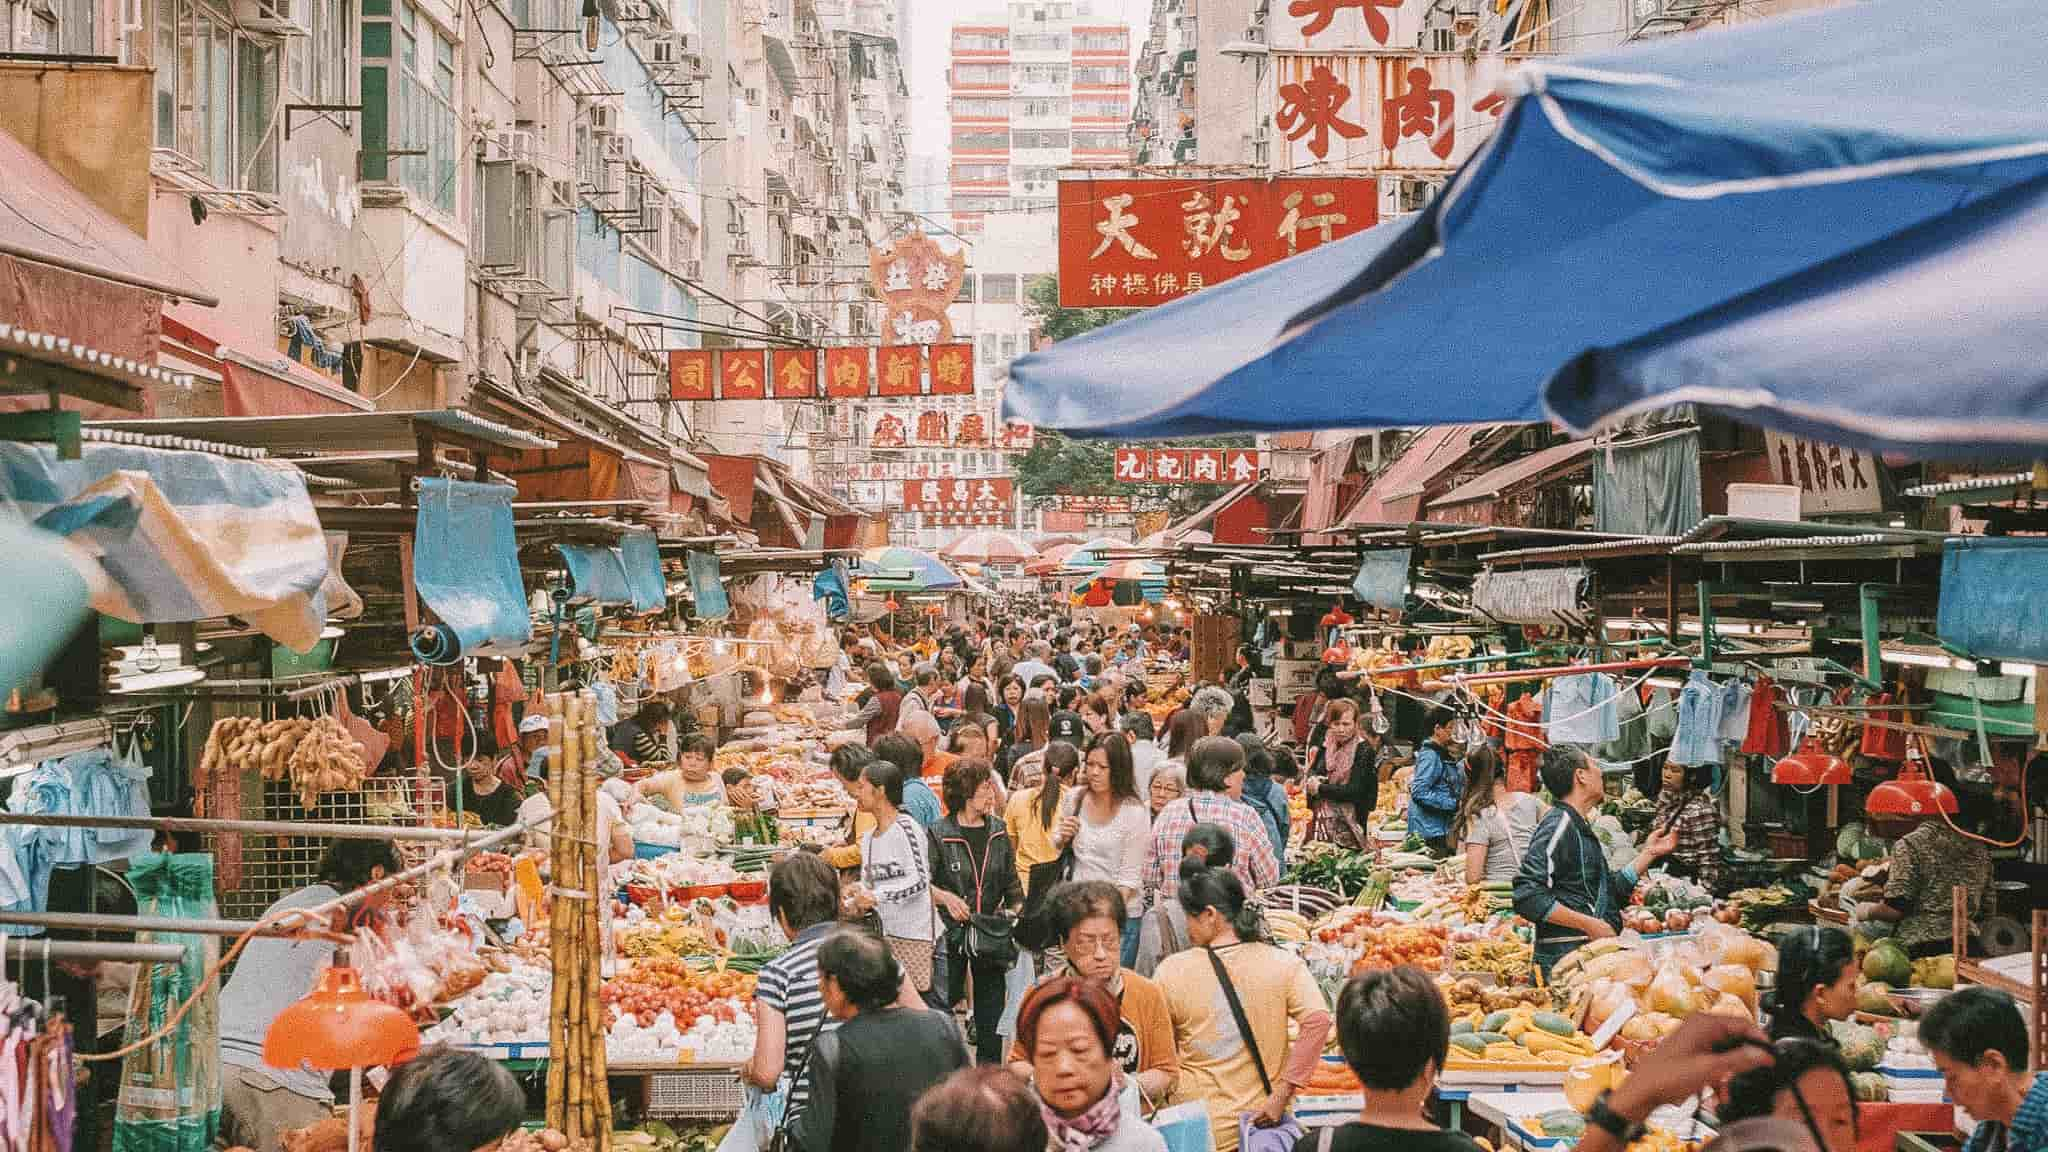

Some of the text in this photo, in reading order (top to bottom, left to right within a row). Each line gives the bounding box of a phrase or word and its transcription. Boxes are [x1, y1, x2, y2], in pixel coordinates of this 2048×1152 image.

[1276, 65, 1508, 160] 凍肉
[1089, 191, 1347, 261] 天就行
[1118, 453, 1257, 480] 九記肉食
